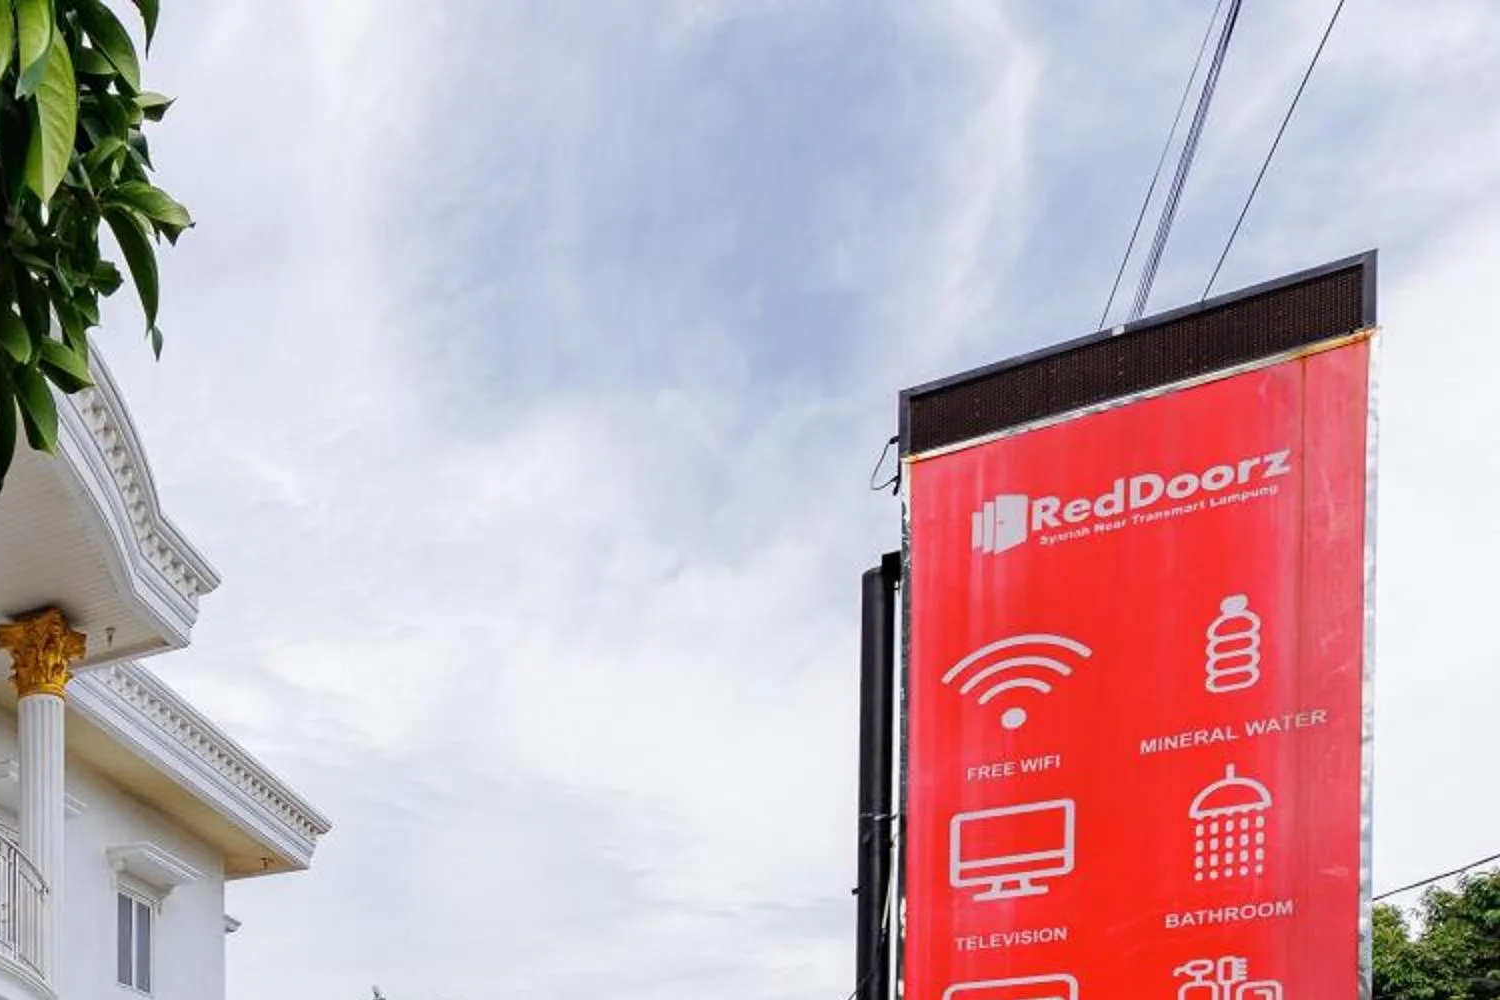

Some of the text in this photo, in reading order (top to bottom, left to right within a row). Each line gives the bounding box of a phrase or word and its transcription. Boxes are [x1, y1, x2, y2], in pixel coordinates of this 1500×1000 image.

[1031, 448, 1291, 531] RedDoorz
[1094, 519, 1127, 534] Near
[1132, 501, 1205, 526] Transmart
[1209, 484, 1279, 507] Lampung
[1140, 709, 1328, 754] MINERAL WATER
[967, 754, 1061, 781] FREE WIFI
[1165, 900, 1293, 929] BATHROOM
[955, 927, 1068, 952] TELEVISION
